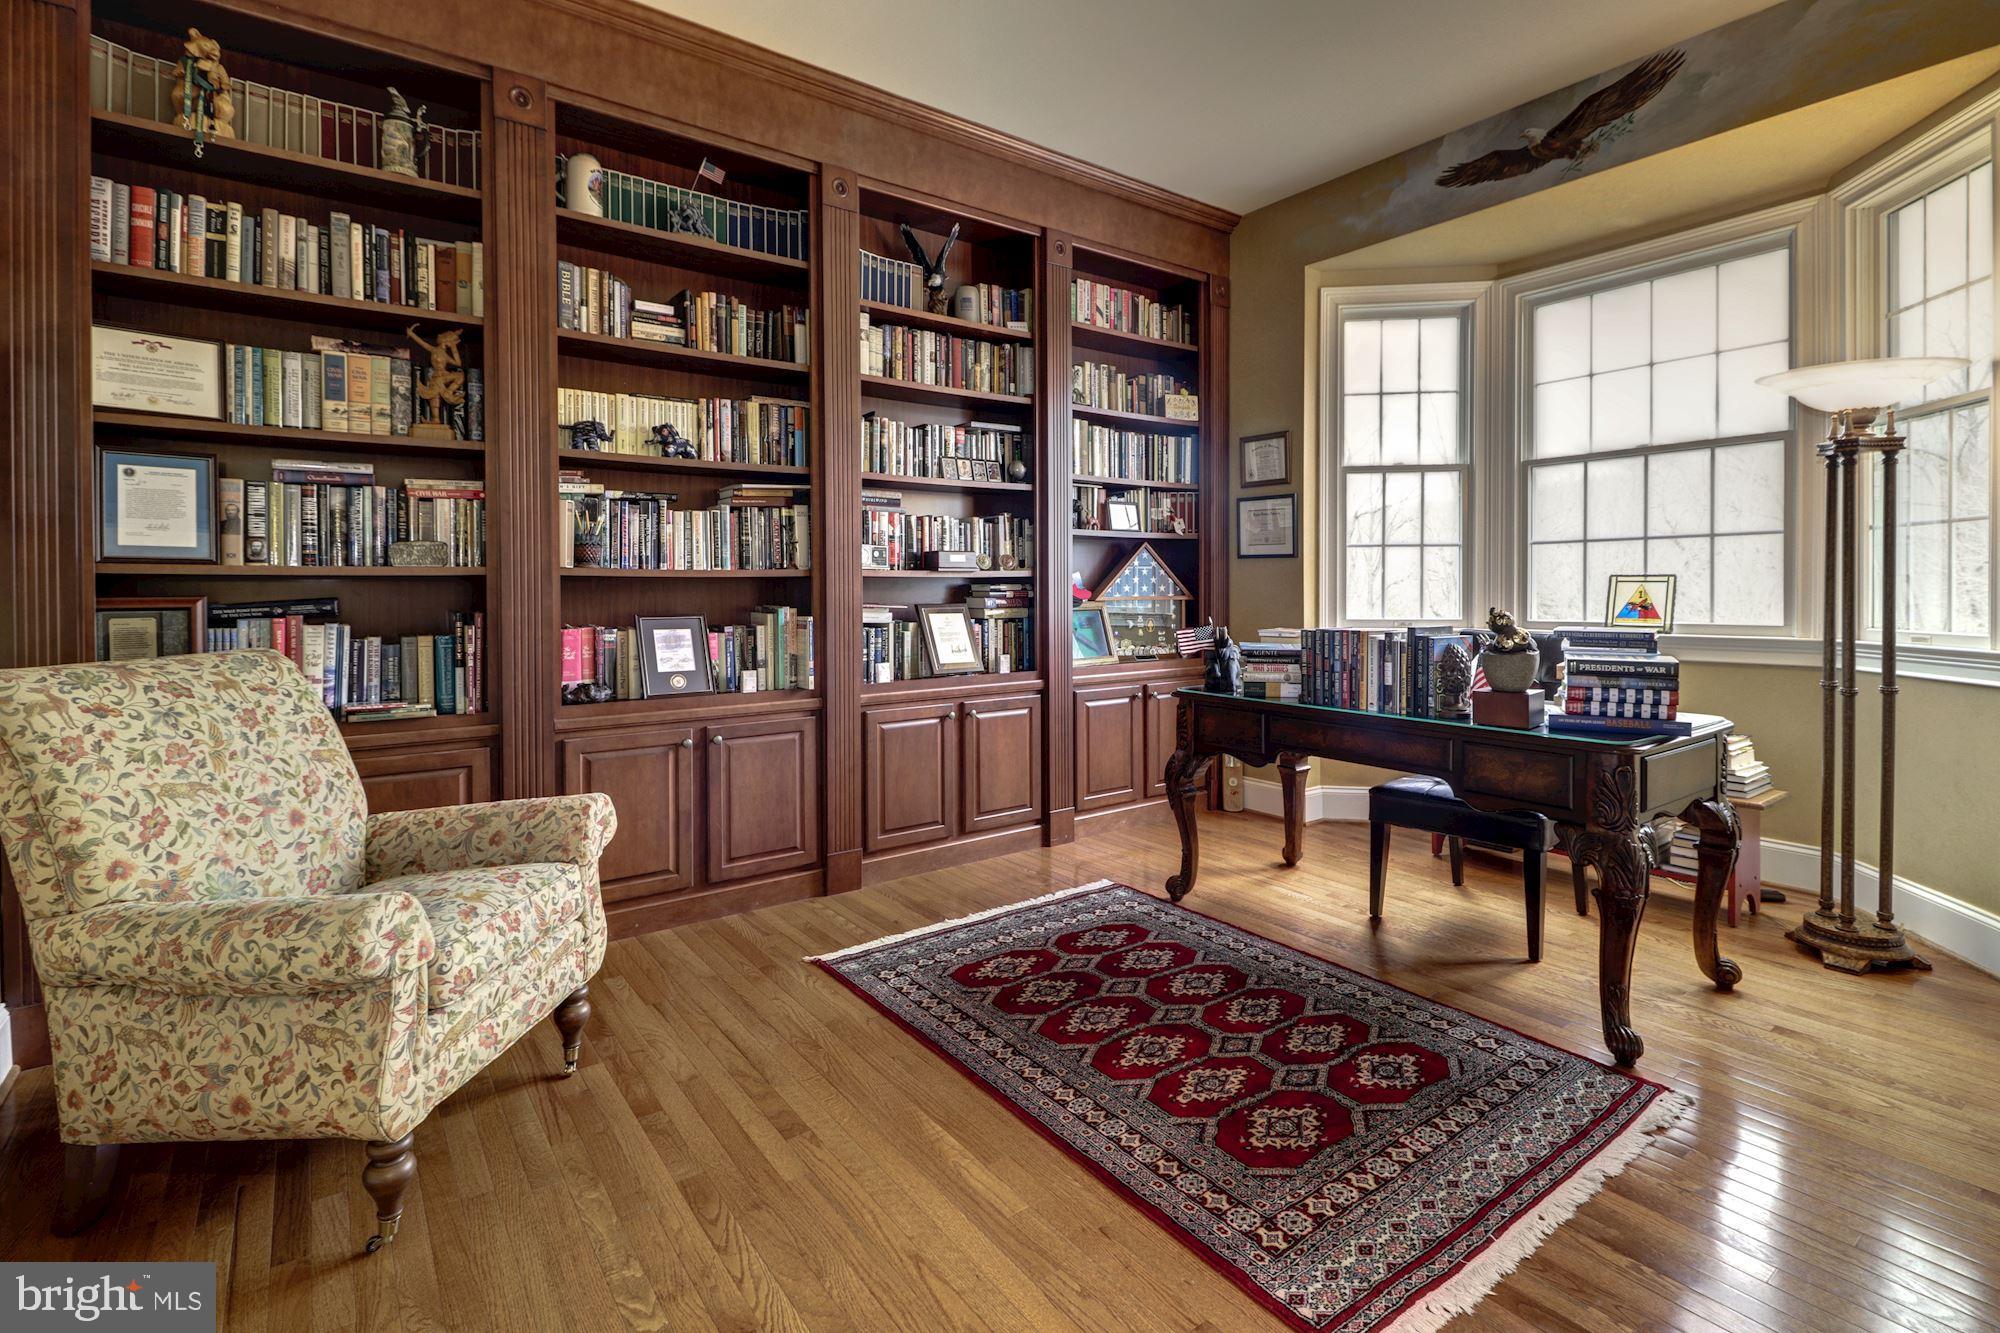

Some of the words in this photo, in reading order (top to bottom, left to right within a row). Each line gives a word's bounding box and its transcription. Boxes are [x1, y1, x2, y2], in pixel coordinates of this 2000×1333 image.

[91, 199, 100, 244] VICTORY
[562, 271, 571, 305] BIBLE
[248, 486, 265, 514] STONEWALL
[302, 498, 317, 523] ROBERT
[248, 516, 265, 537] JACKSON
[302, 533, 317, 545] LEE
[1638, 590, 1643, 598] 1
[1266, 664, 1288, 672] STORIES
[1579, 663, 1636, 672] PRESIDENTS
[1606, 720, 1652, 729] BASEBALL
